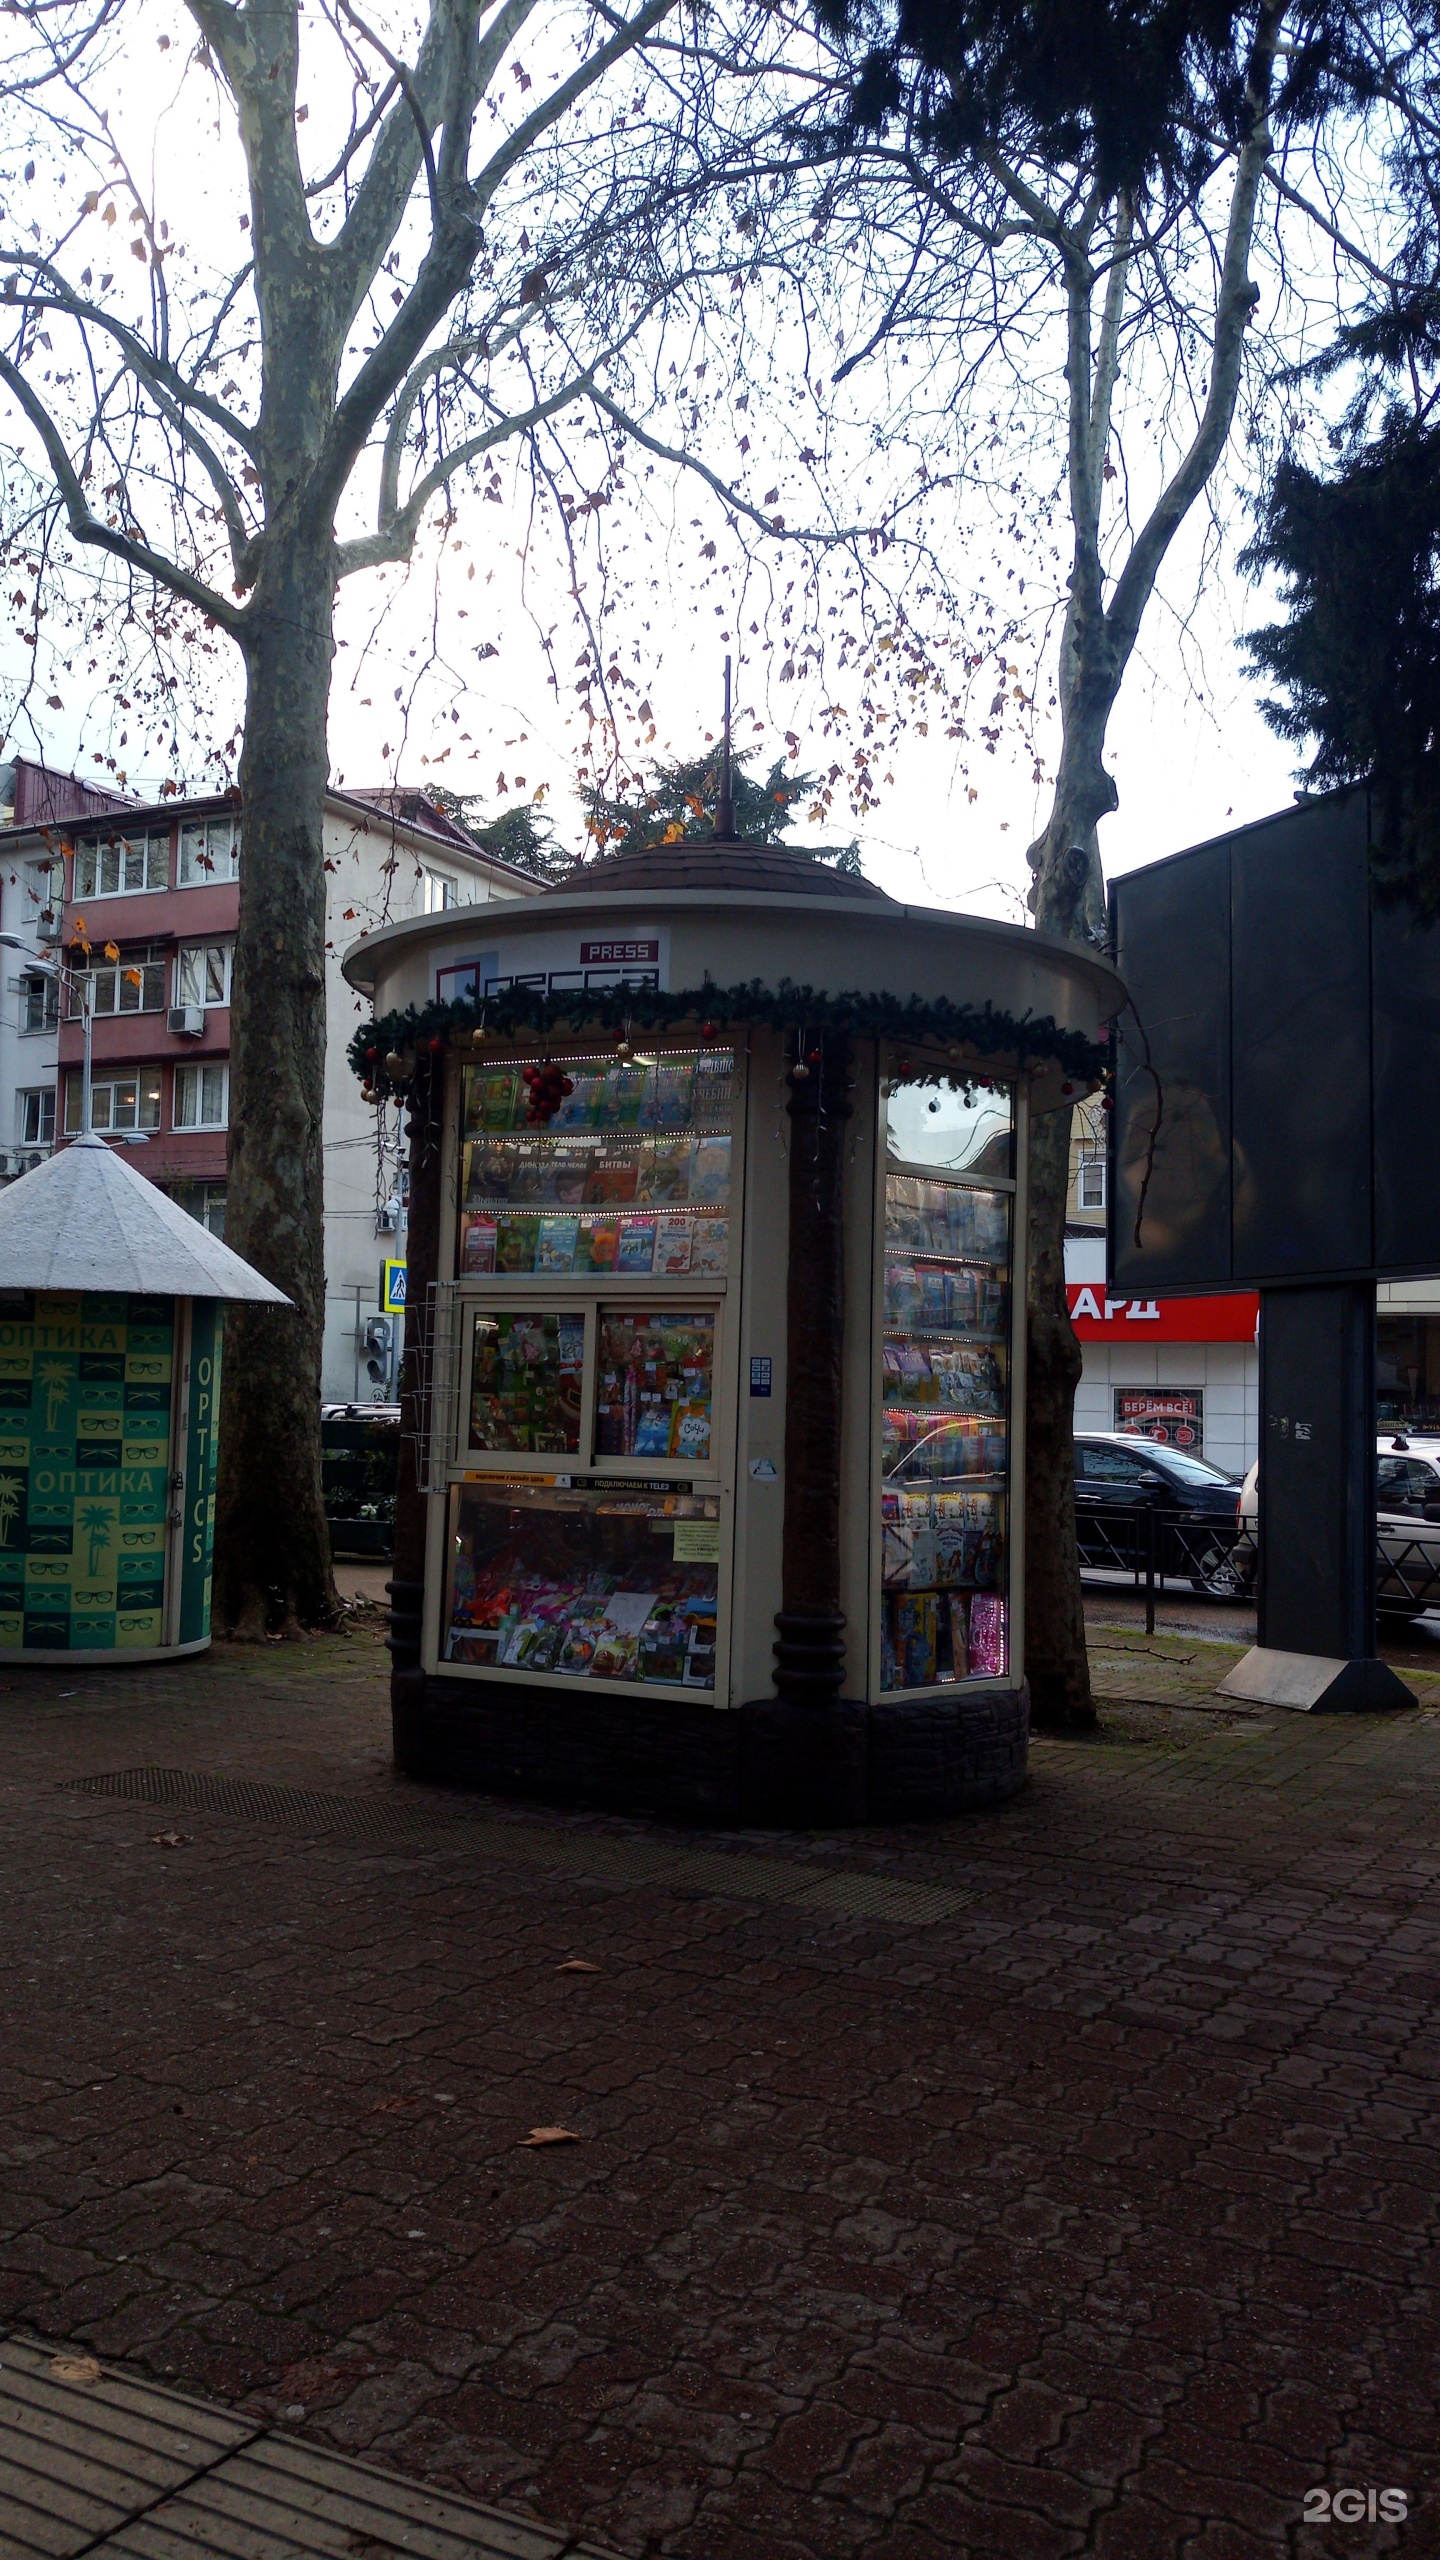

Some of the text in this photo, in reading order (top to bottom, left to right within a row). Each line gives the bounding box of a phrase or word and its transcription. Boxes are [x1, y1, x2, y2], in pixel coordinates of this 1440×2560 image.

[590, 943, 649, 959] PRESS
[599, 1160, 631, 1169] БИТВЫ
[668, 1217, 685, 1226] 200
[0, 1325, 118, 1349] ОПТИКА
[1124, 1400, 1193, 1413] БЕРЁМ ВСЁ!
[192, 1357, 212, 1563] OPTICS
[35, 1471, 154, 1493] ОПТИКА
[594, 1480, 642, 1488] ПОДКЛЮЧАЕМ
[649, 1482, 670, 1490] TELE2
